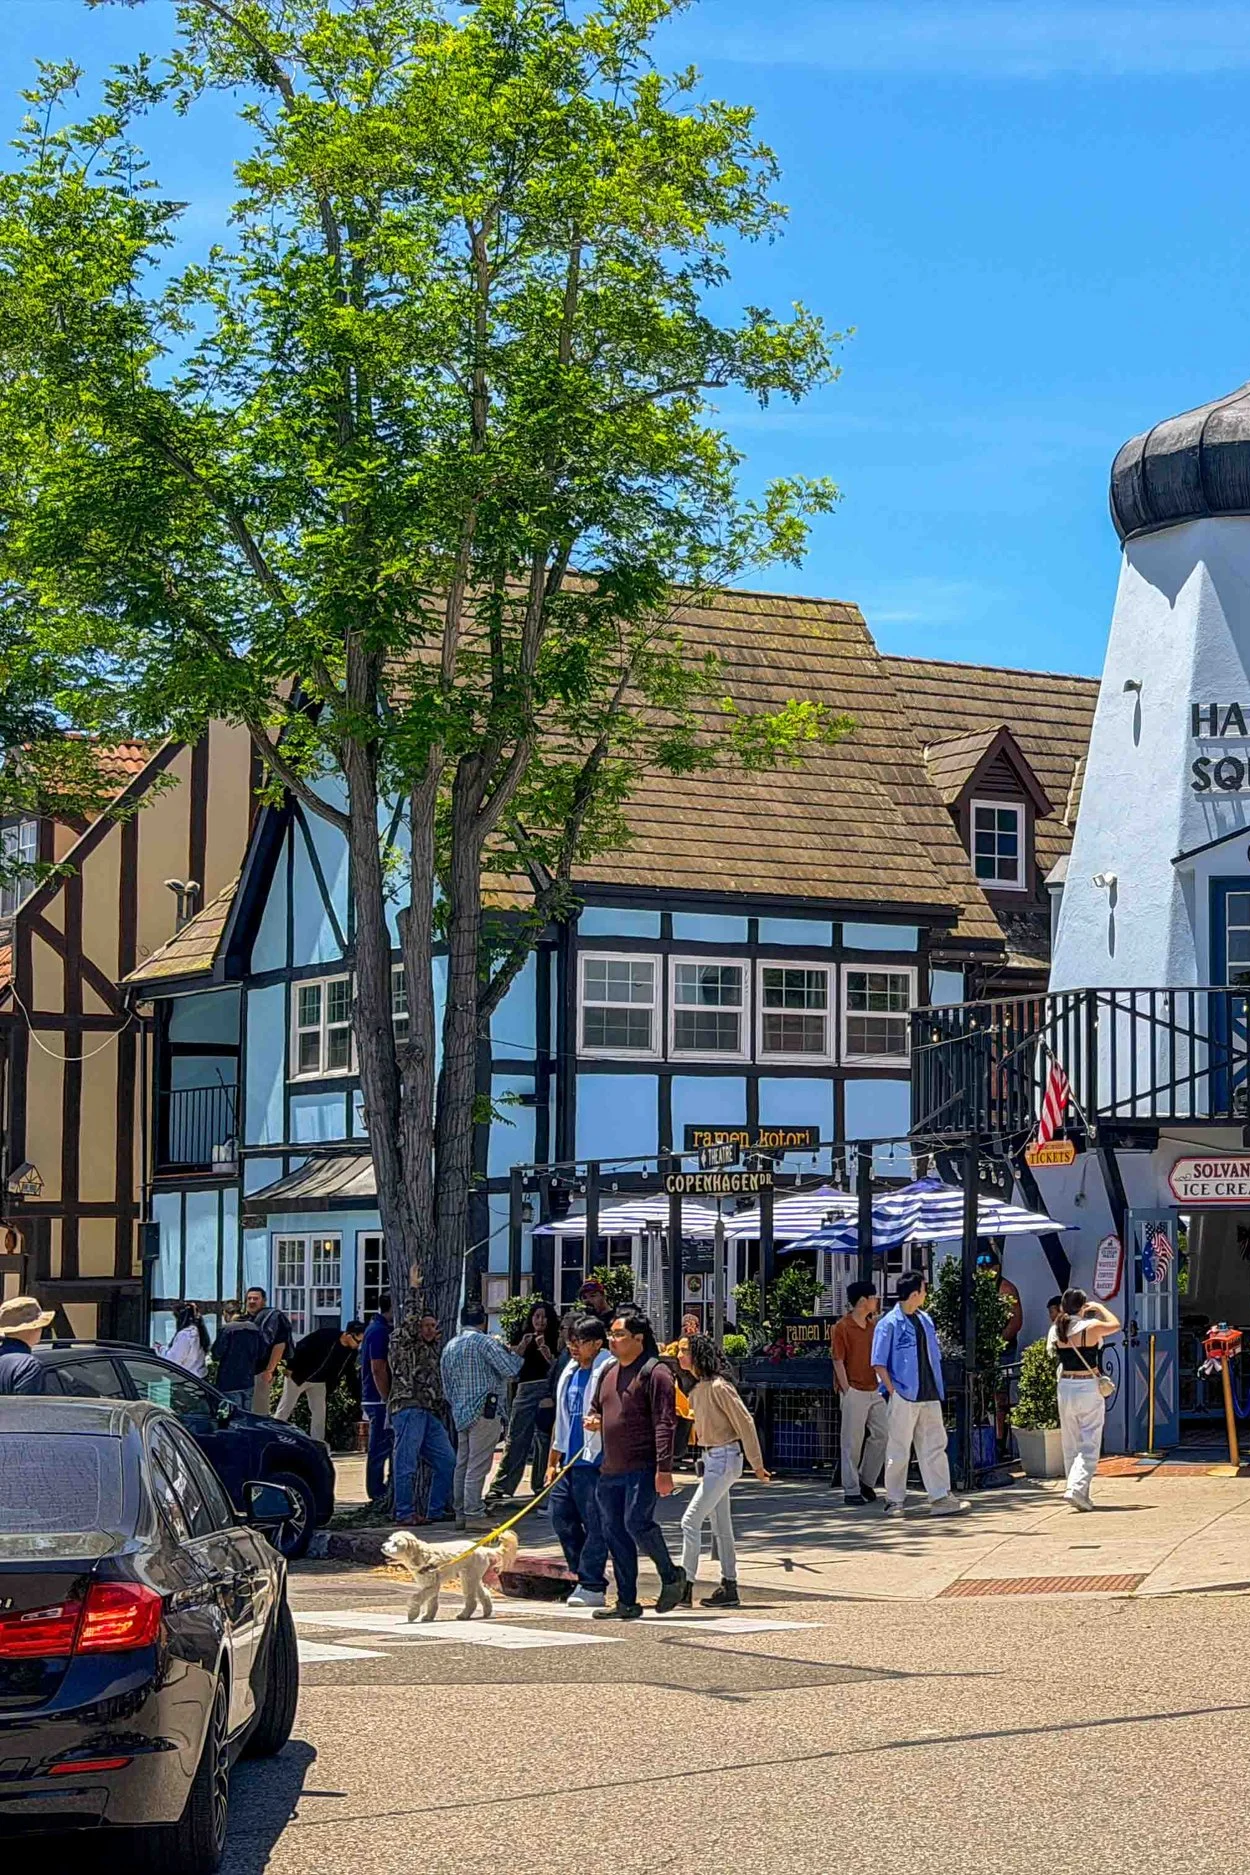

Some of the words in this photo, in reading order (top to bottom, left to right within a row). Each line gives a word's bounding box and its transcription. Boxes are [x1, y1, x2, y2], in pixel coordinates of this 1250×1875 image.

[693, 1130, 750, 1148] ramen
[759, 1128, 811, 1147] kotori
[708, 1145, 734, 1166] THEATRE
[1030, 1151, 1071, 1164] TICKETS
[666, 1174, 759, 1193] COPENHAGEN
[1184, 1183, 1210, 1196] ICE
[785, 1324, 820, 1343] ramen
